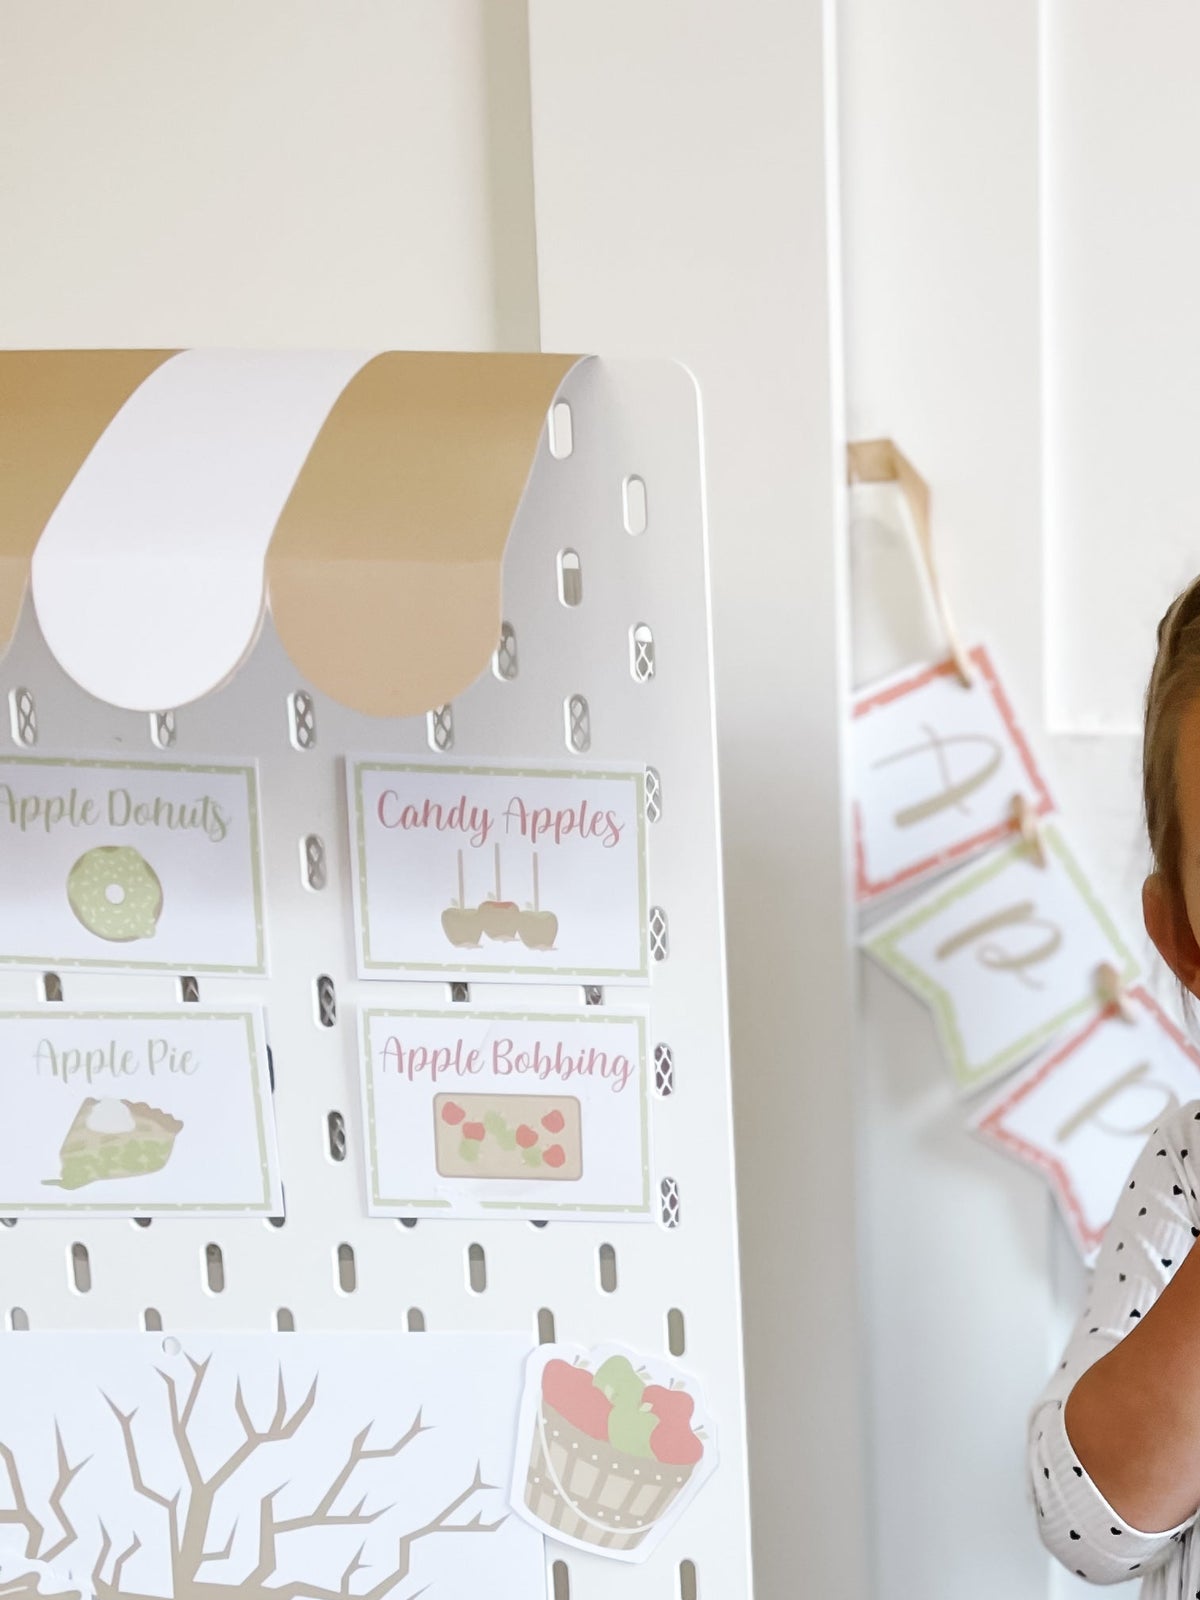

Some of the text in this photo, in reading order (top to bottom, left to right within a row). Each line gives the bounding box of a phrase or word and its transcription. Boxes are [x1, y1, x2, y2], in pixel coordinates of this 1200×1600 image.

[108, 787, 232, 843] Donuts
[377, 789, 625, 849] Candy Apples
[32, 1037, 200, 1084] Apple Pie
[379, 1035, 635, 1093] Apple Bobbing
